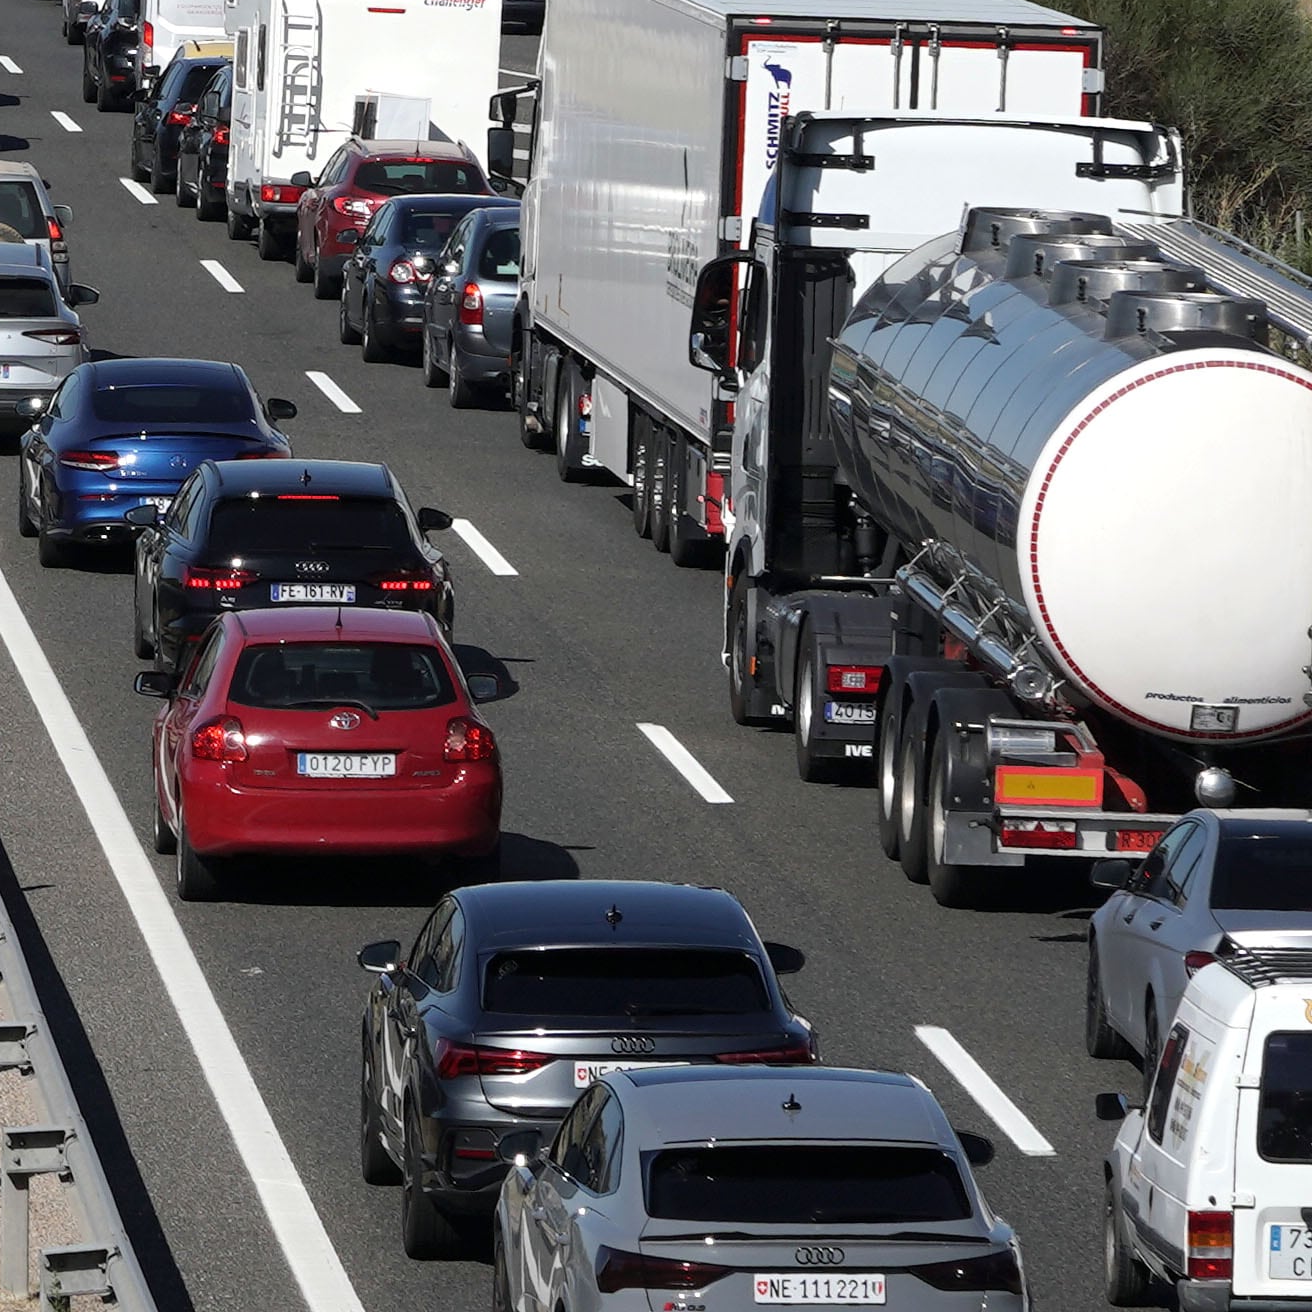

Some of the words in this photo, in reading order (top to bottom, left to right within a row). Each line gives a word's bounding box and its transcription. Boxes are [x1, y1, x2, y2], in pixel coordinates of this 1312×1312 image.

[766, 91, 780, 170] SCHMITZ
[1145, 691, 1204, 703] productos
[835, 704, 874, 718] 4015
[845, 744, 873, 757] IVE
[309, 756, 353, 772] 0120
[359, 757, 392, 773] FYP
